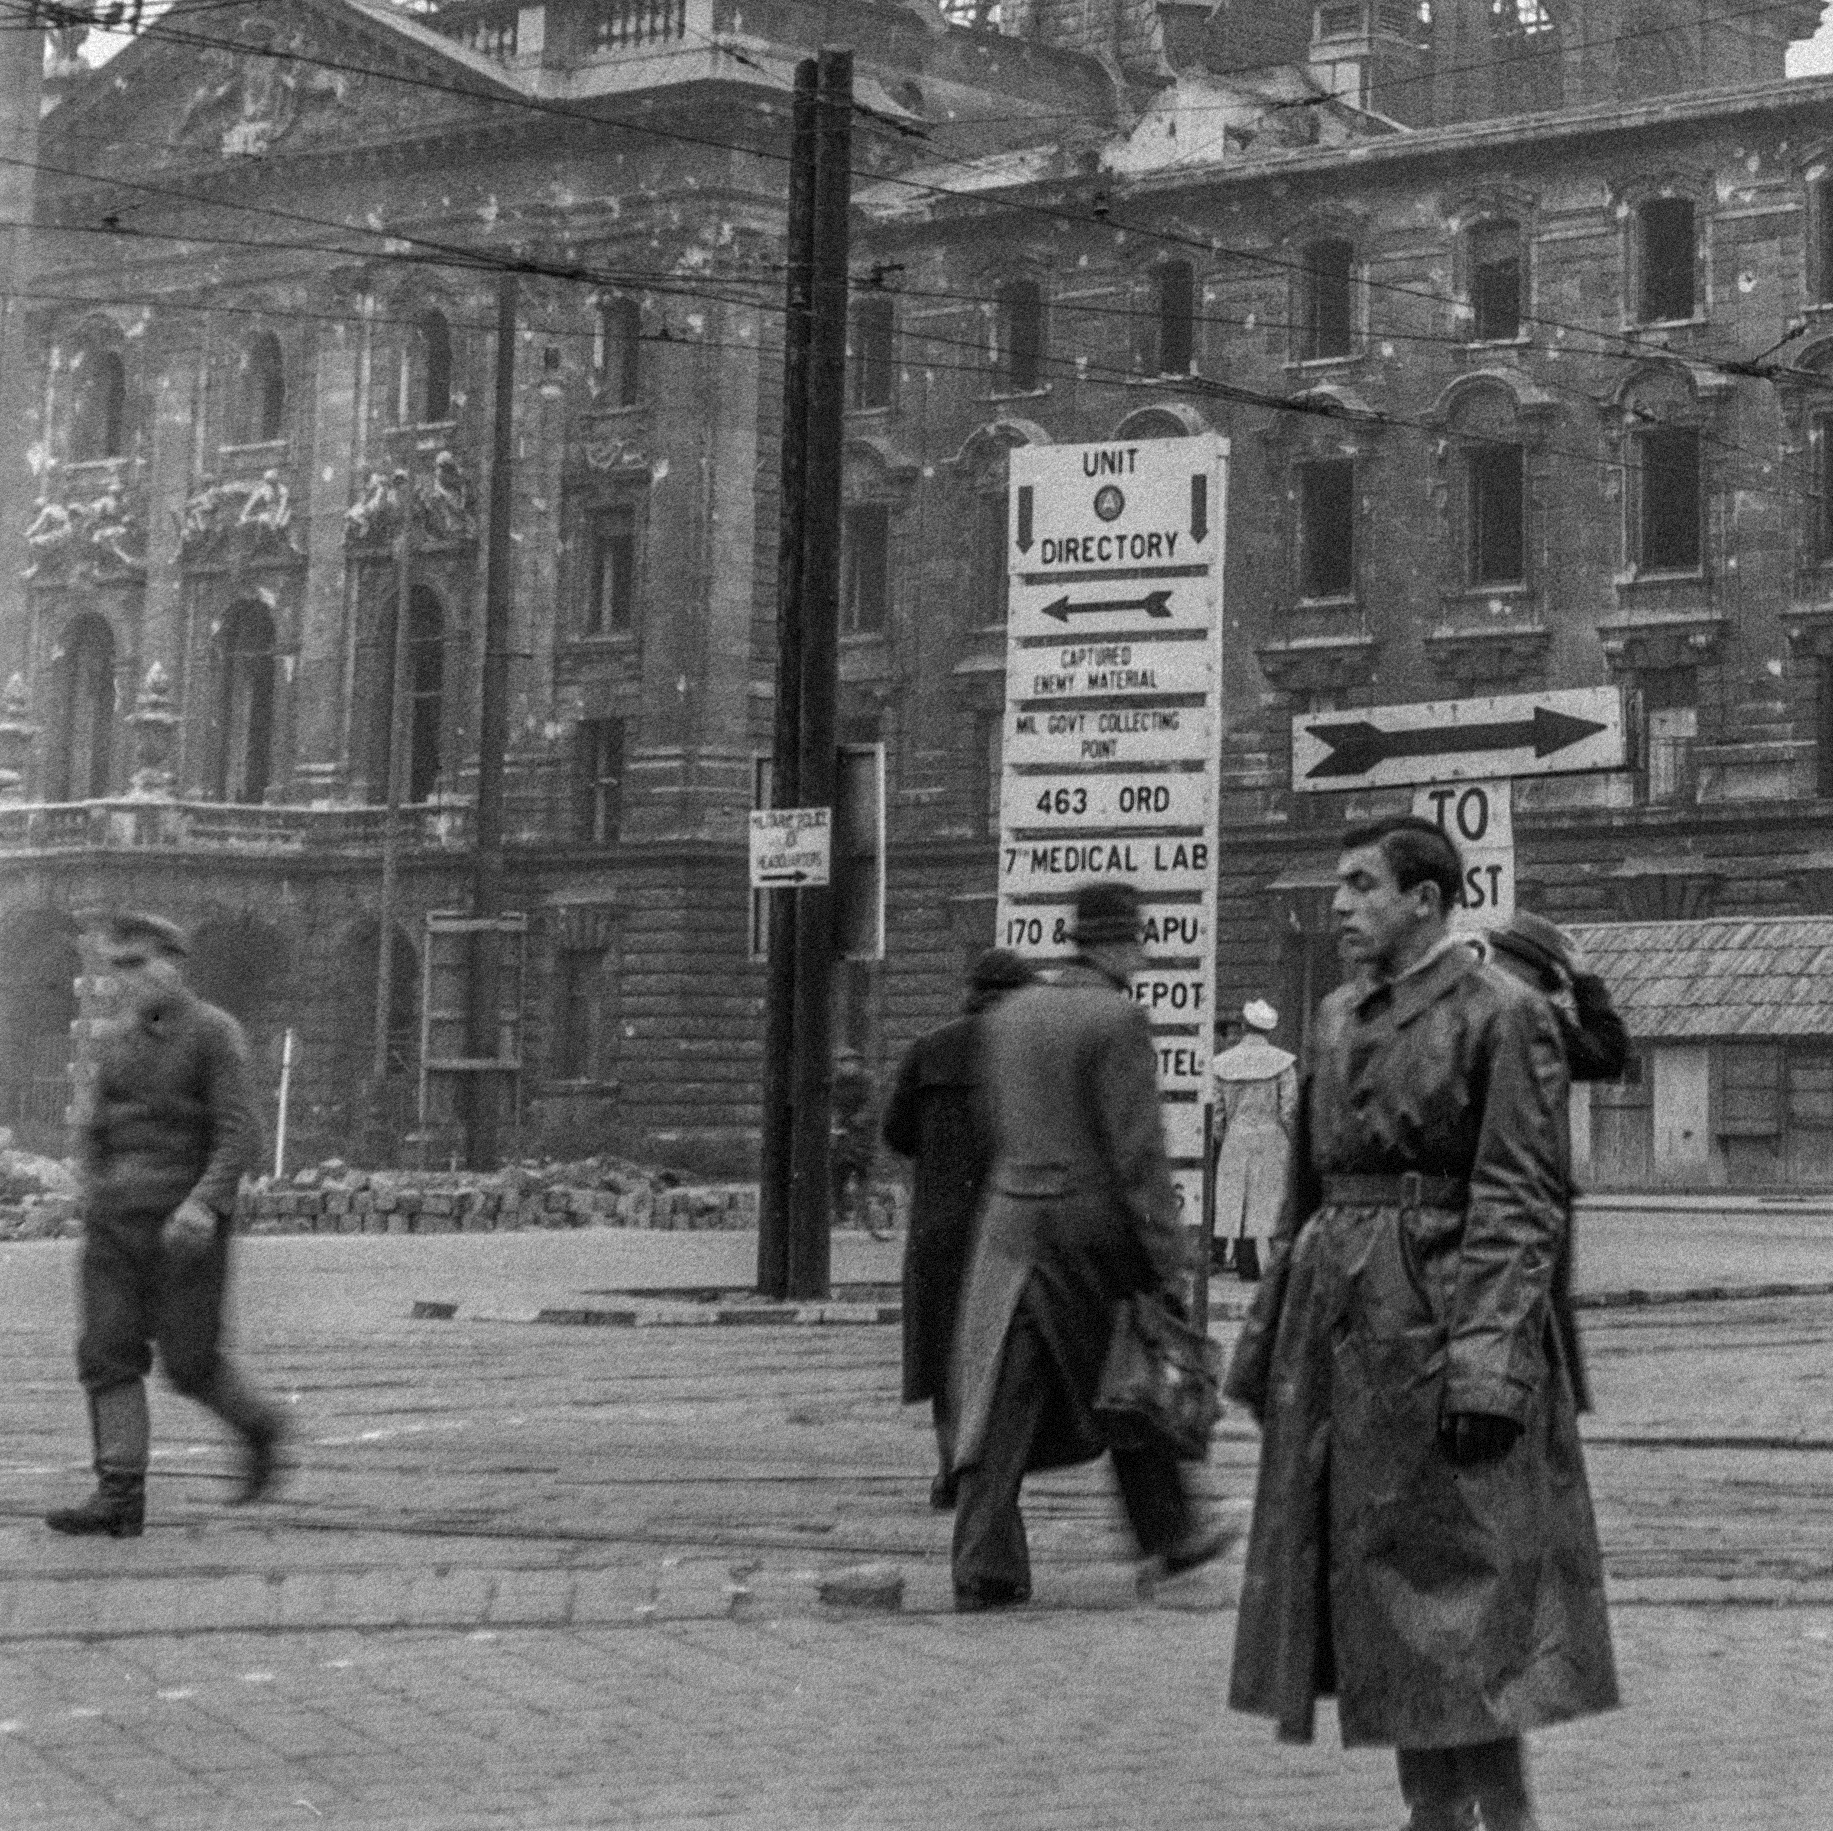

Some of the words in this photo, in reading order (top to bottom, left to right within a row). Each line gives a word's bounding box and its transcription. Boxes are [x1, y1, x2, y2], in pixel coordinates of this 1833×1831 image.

[1083, 448, 1138, 477] UNIT
[1041, 531, 1178, 564] DIRECTORY
[1061, 646, 1132, 668] CAPTURED
[1034, 673, 1074, 694] ENEMY
[1088, 668, 1157, 690] MATERIAL
[1016, 716, 1038, 735] MIL
[1048, 714, 1085, 735] GOVT
[1099, 710, 1180, 733] COLLECTING
[1081, 739, 1117, 758] POINT
[1036, 788, 1087, 814] 463
[1119, 785, 1170, 813] ORD
[1428, 786, 1489, 842] TO
[1031, 845, 1138, 874] MEDICAL
[1154, 843, 1209, 871] LAB
[1462, 864, 1503, 909] ST
[1007, 919, 1042, 946] 170
[1053, 918, 1067, 944] &
[1142, 917, 1199, 944] APU
